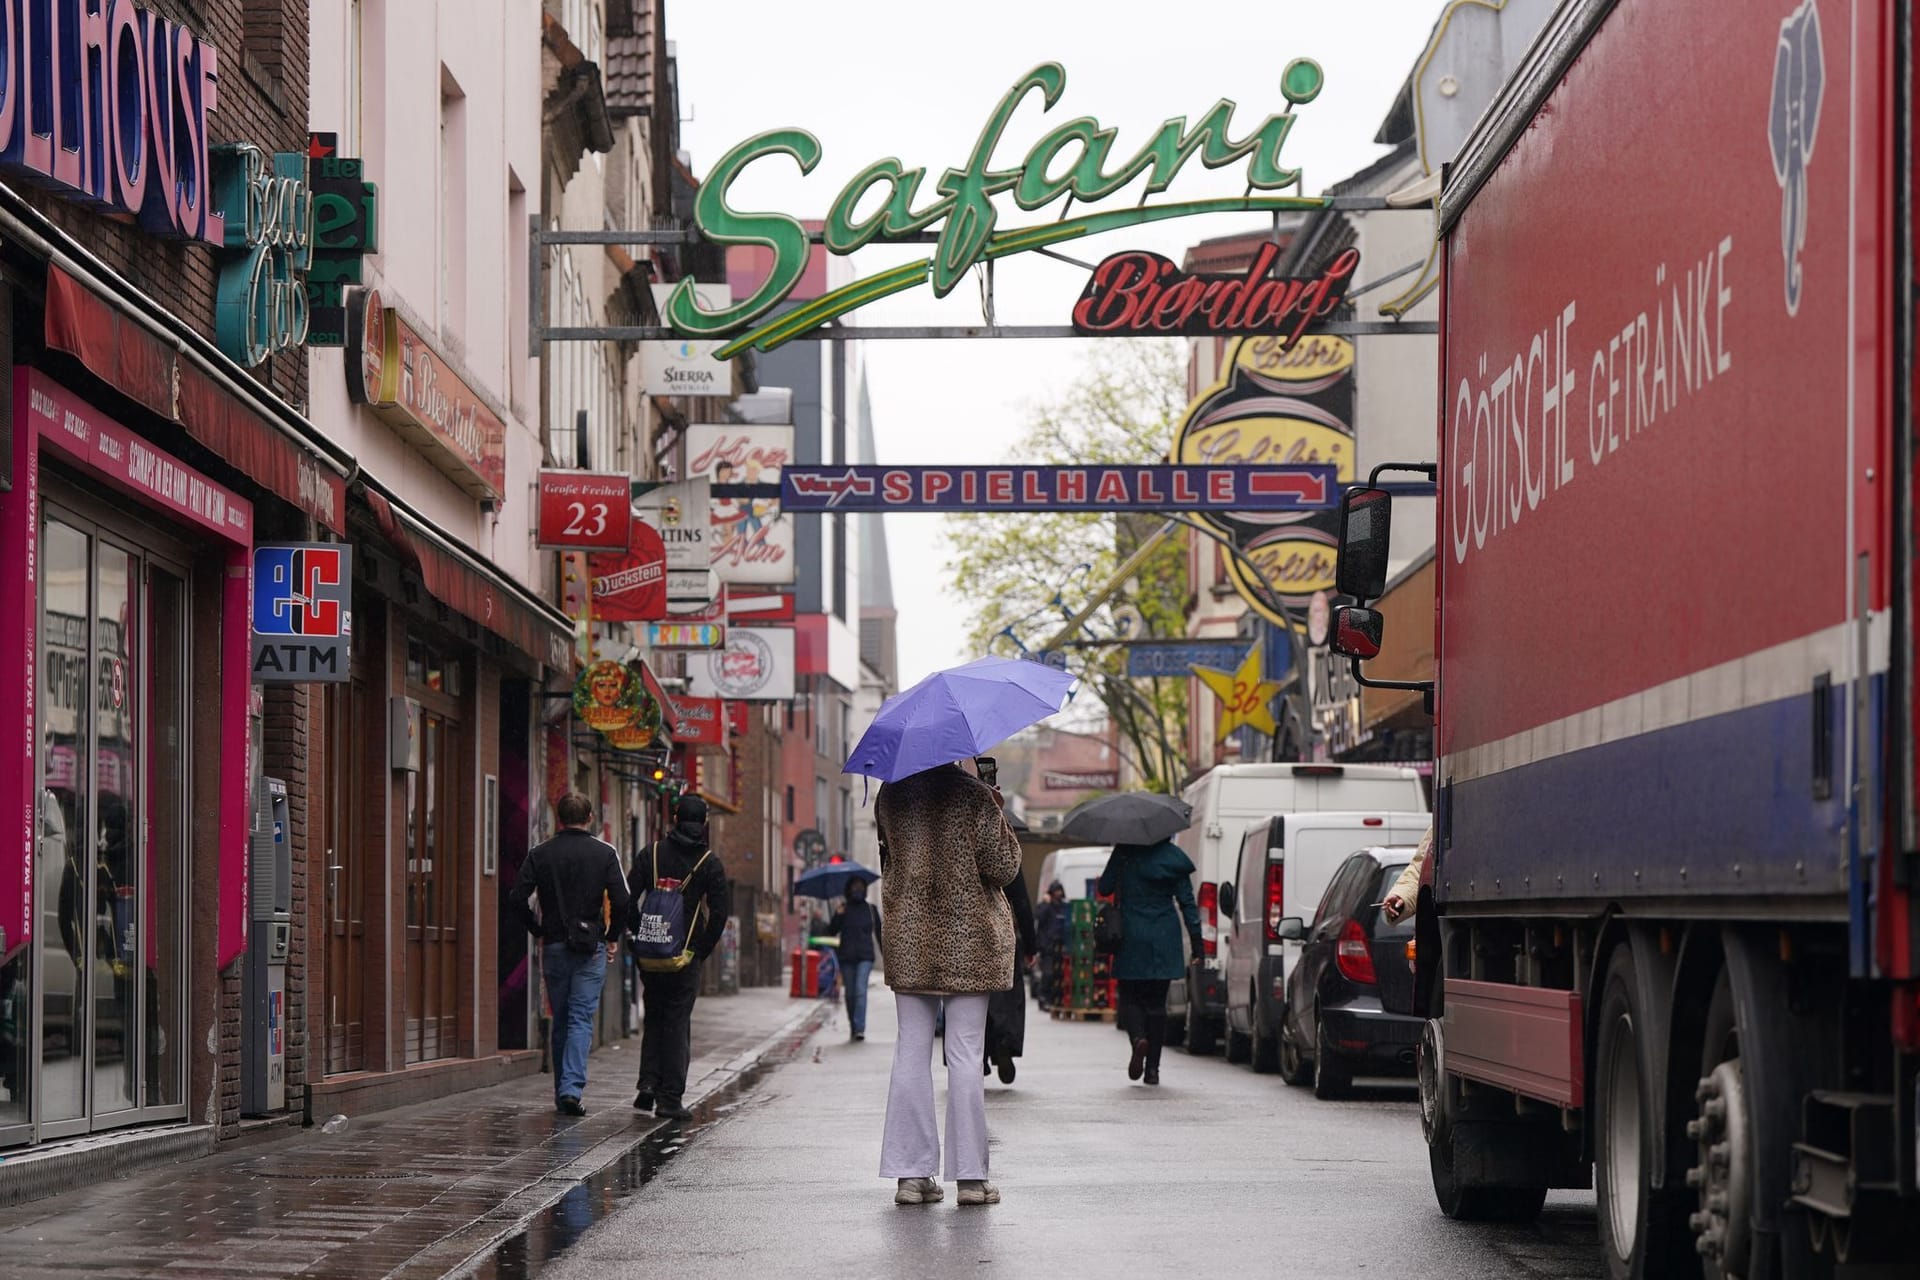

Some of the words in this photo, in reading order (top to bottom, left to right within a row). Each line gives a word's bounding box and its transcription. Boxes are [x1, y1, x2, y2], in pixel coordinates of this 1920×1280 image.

[666, 58, 1324, 338] Safari
[1072, 242, 1359, 351] Bierdorf
[1252, 339, 1345, 370] Colibri
[1589, 234, 1733, 466] GETRÄNKE
[663, 366, 714, 382] SIERRA
[417, 354, 484, 463] Bierstube
[544, 484, 579, 497] Große
[581, 484, 625, 498] Freiheit
[882, 470, 1237, 503] SPIELHALLE
[562, 502, 609, 537] 23
[253, 644, 337, 674] ATM
[1225, 680, 1261, 715] 36
